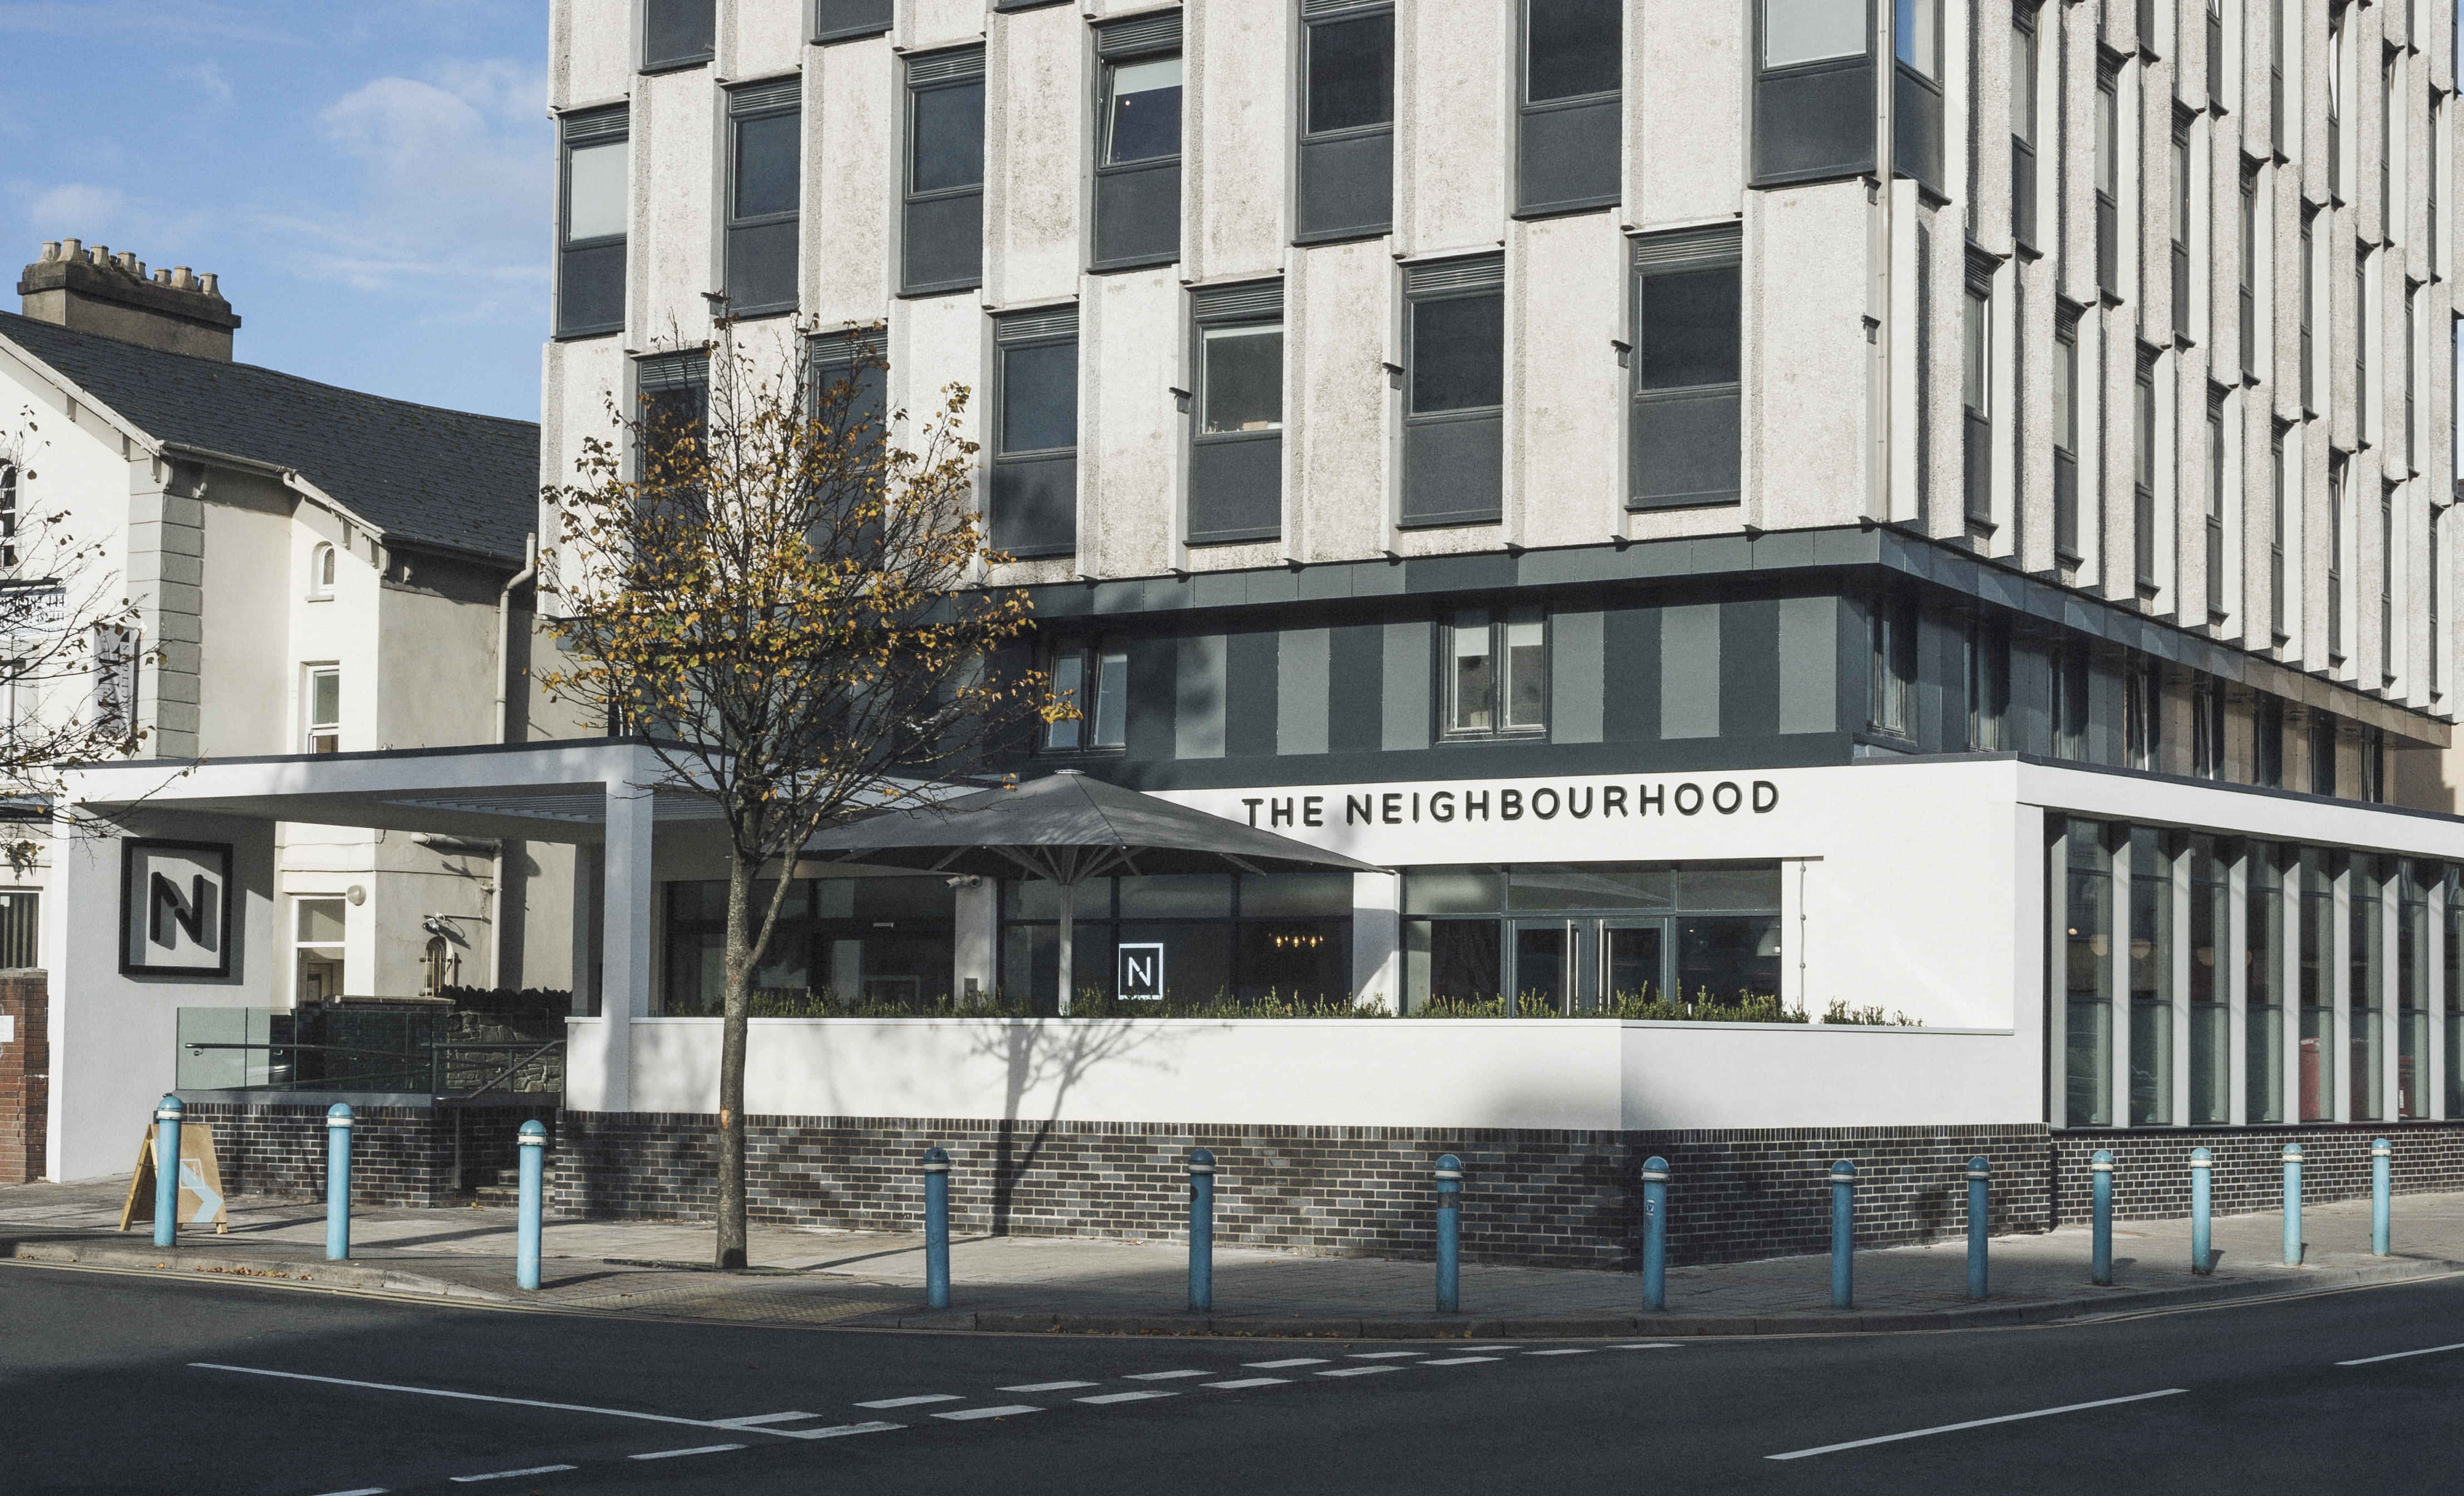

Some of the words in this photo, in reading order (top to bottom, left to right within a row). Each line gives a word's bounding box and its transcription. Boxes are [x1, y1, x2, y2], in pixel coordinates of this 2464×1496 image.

[121, 644, 131, 735] OLCITOS
[1241, 796, 1324, 828] THE
[1346, 780, 1779, 826] NEIGHBOURHOOD
[150, 872, 204, 943] N
[1128, 957, 1151, 987] N
